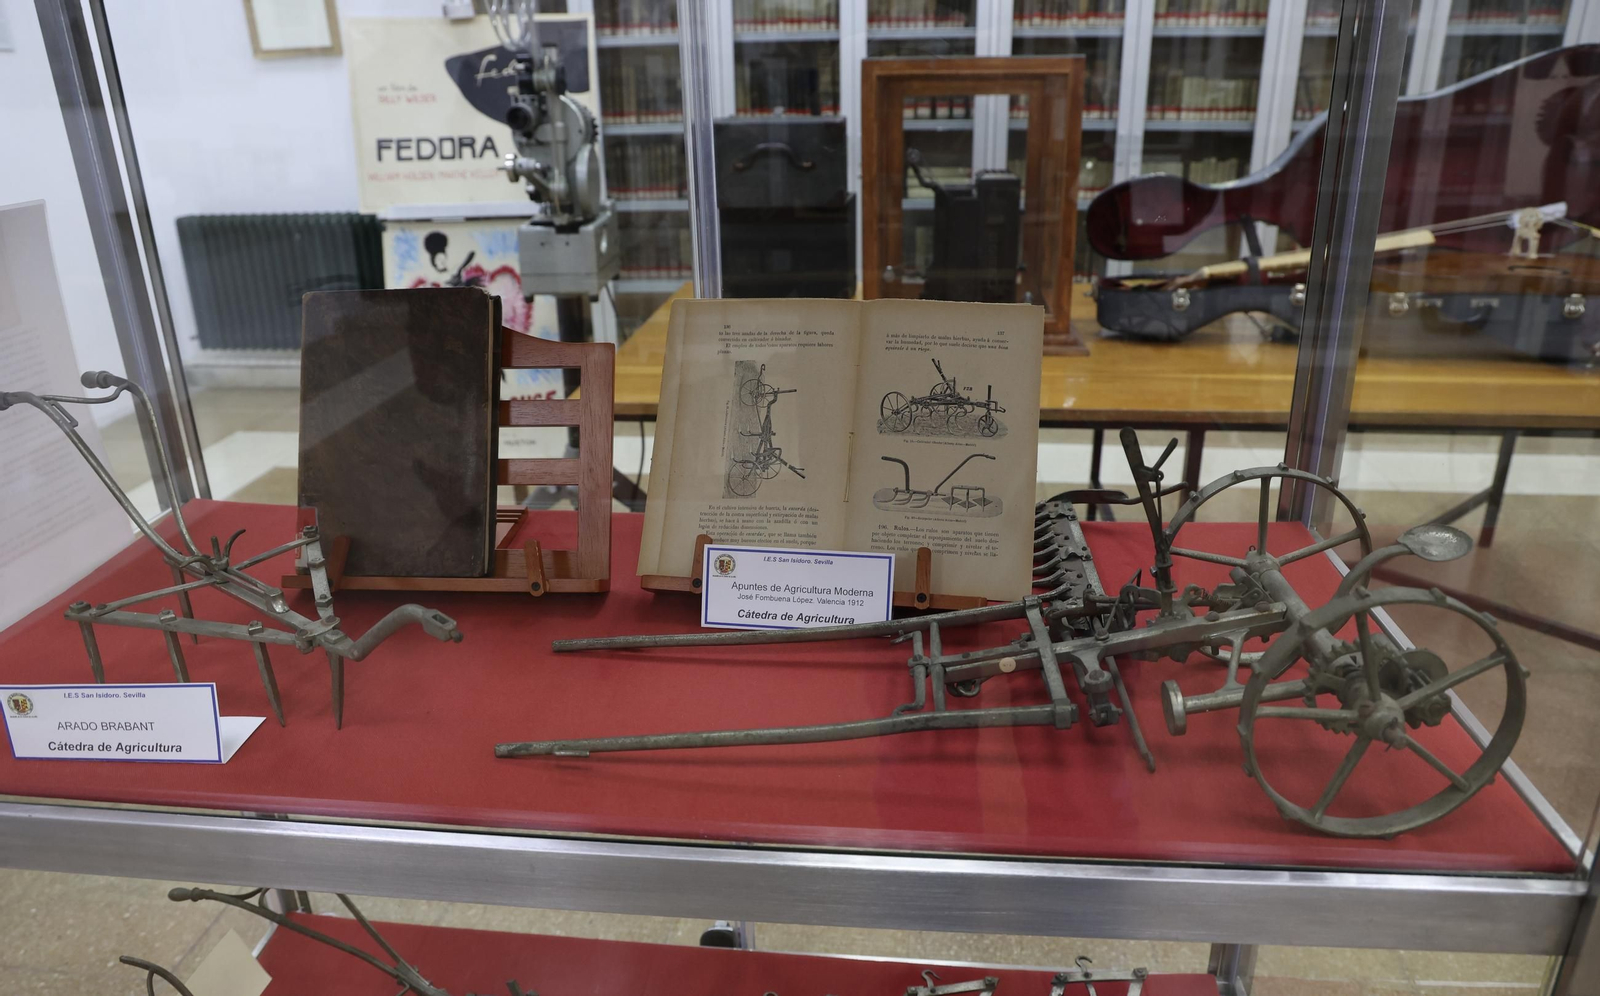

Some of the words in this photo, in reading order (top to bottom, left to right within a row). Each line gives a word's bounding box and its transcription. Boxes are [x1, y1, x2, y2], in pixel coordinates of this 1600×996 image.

[376, 136, 499, 162] FEDORA
[731, 582, 768, 592] Apuntes
[770, 583, 782, 592] de
[784, 584, 832, 596] Agricultura
[834, 586, 874, 597] Moderna
[737, 593, 753, 601] José
[755, 594, 791, 603] Fombuena
[817, 598, 845, 606] Valencia
[847, 599, 864, 607] 1912
[737, 609, 778, 621] Cátedra
[781, 611, 793, 621] de
[796, 613, 855, 625] Agricultura
[57, 721, 98, 731] ARADO
[101, 721, 155, 731] BRABANT
[48, 741, 94, 752] Cátedra
[97, 741, 112, 752] de
[115, 742, 182, 755] Agricultura
